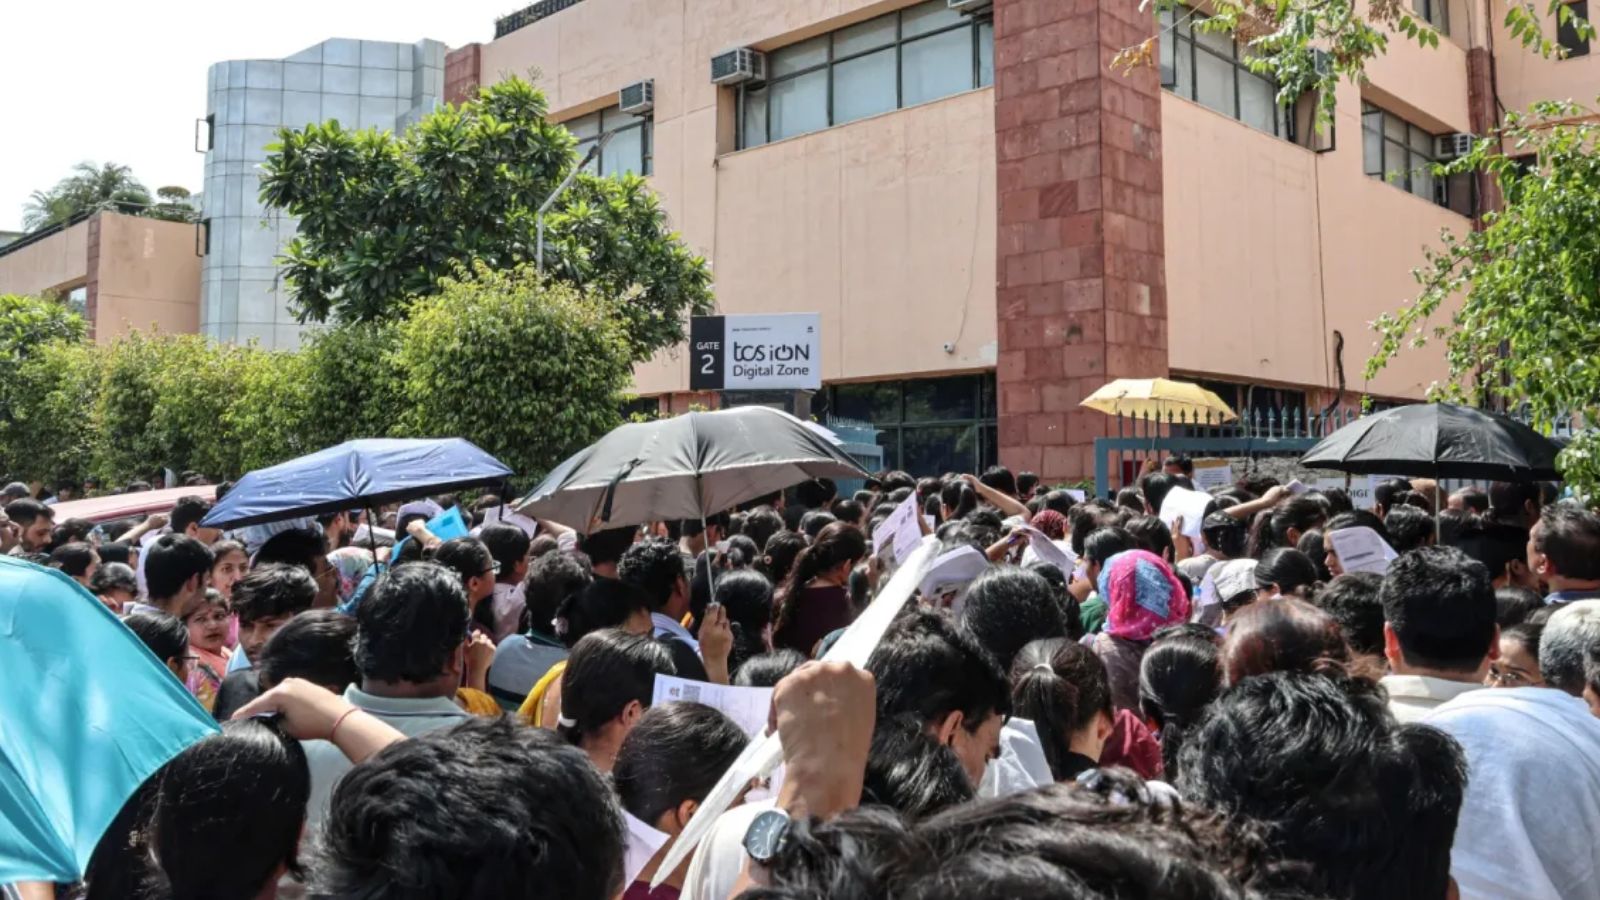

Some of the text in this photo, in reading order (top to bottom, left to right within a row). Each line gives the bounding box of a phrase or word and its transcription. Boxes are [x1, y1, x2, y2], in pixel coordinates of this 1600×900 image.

[696, 341, 720, 350] GATE
[701, 354, 715, 374] 2
[733, 364, 809, 380] Digital Zone
